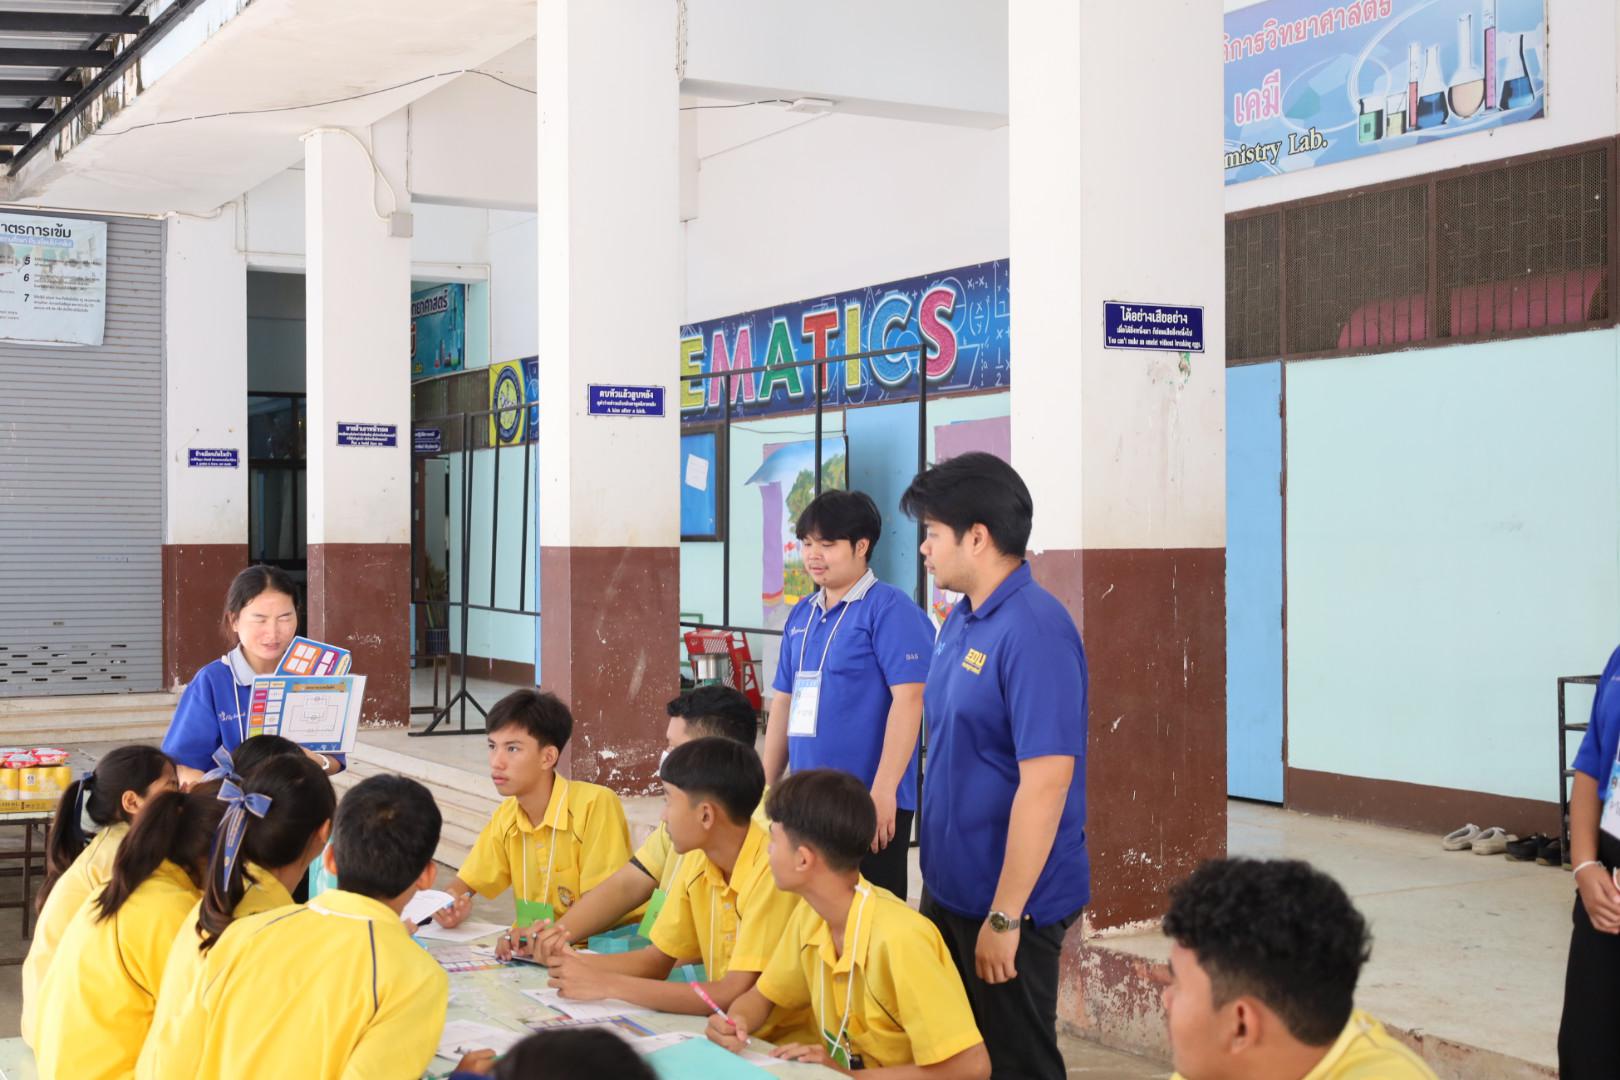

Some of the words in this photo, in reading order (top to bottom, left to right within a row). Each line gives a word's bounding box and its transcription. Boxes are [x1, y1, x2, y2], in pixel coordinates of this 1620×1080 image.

[1234, 68, 1281, 127] เคมี
[1224, 141, 1282, 169] mistry
[1288, 126, 1328, 155] Lab.
[24, 256, 31, 265] 5
[23, 273, 30, 282] 6
[24, 293, 30, 302] 7
[1120, 305, 1188, 325] ได้อย่างเสียอย่าง
[680, 286, 958, 412] EMATICS
